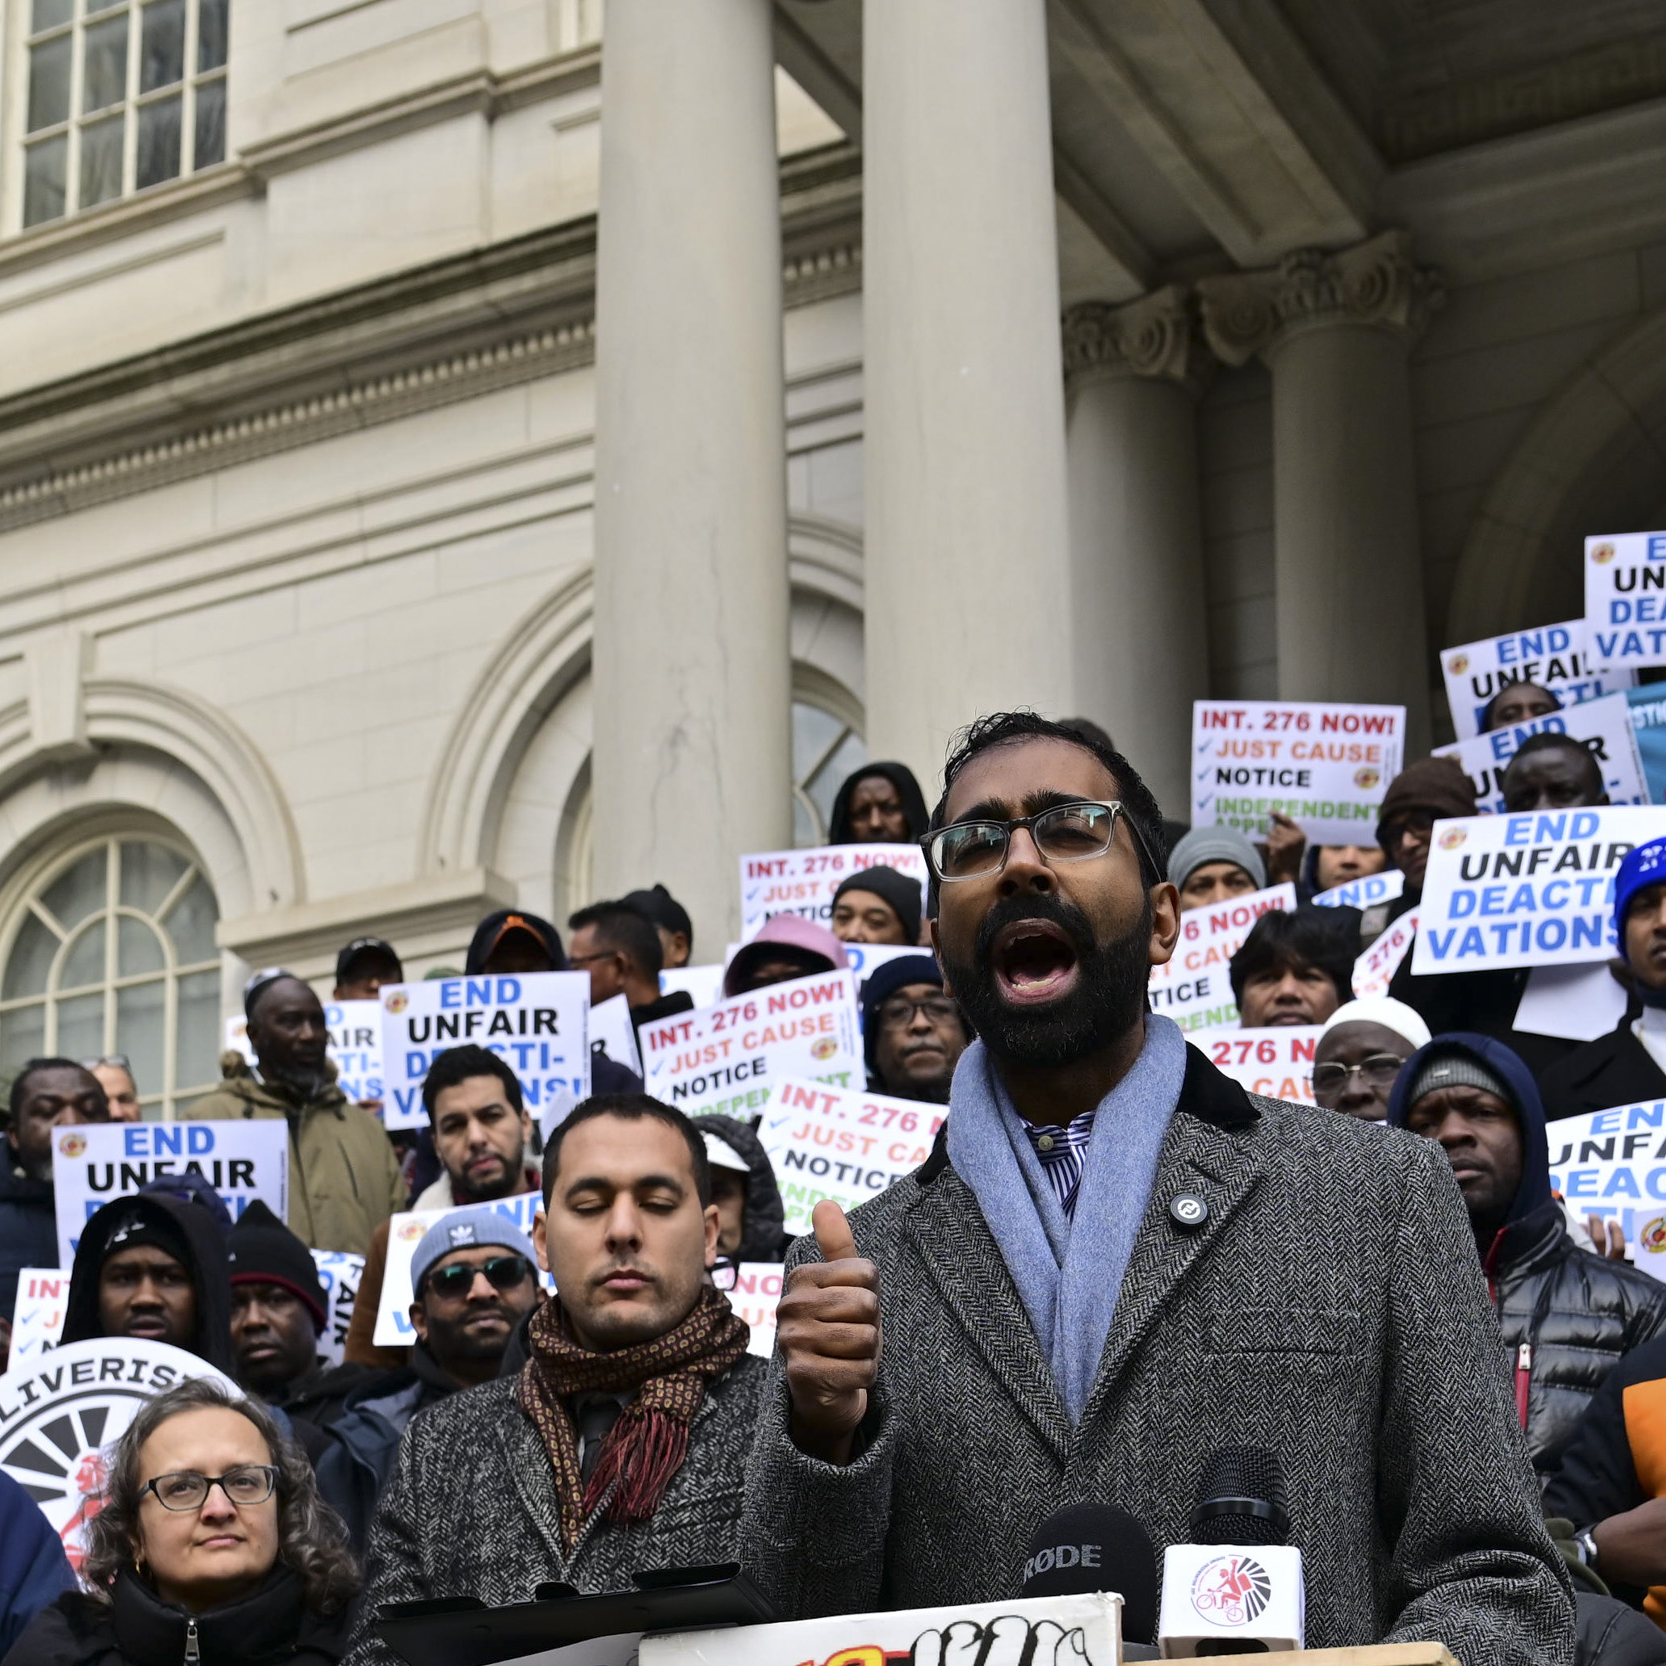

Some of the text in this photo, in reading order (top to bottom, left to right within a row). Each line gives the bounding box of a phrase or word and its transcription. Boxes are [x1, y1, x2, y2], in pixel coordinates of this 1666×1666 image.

[1497, 629, 1570, 664] END
[1202, 711, 1395, 735] INT. 276 NOW!
[1216, 740, 1382, 763] JUST CAUSE
[1216, 768, 1311, 787] NOTICE
[1505, 812, 1600, 846] END
[441, 978, 521, 1008] END
[409, 1009, 559, 1043] UNFAIR
[649, 980, 845, 1050] INT. 276 NOW!
[669, 1013, 834, 1074] JUST CAUSE
[1213, 1040, 1276, 1065] 276
[672, 1057, 766, 1100] NOTICE
[780, 1084, 846, 1118] INT.
[858, 1104, 917, 1132] 276
[124, 1126, 215, 1157] END
[793, 1123, 878, 1156] JUST
[1024, 1544, 1102, 1584] RØDE
